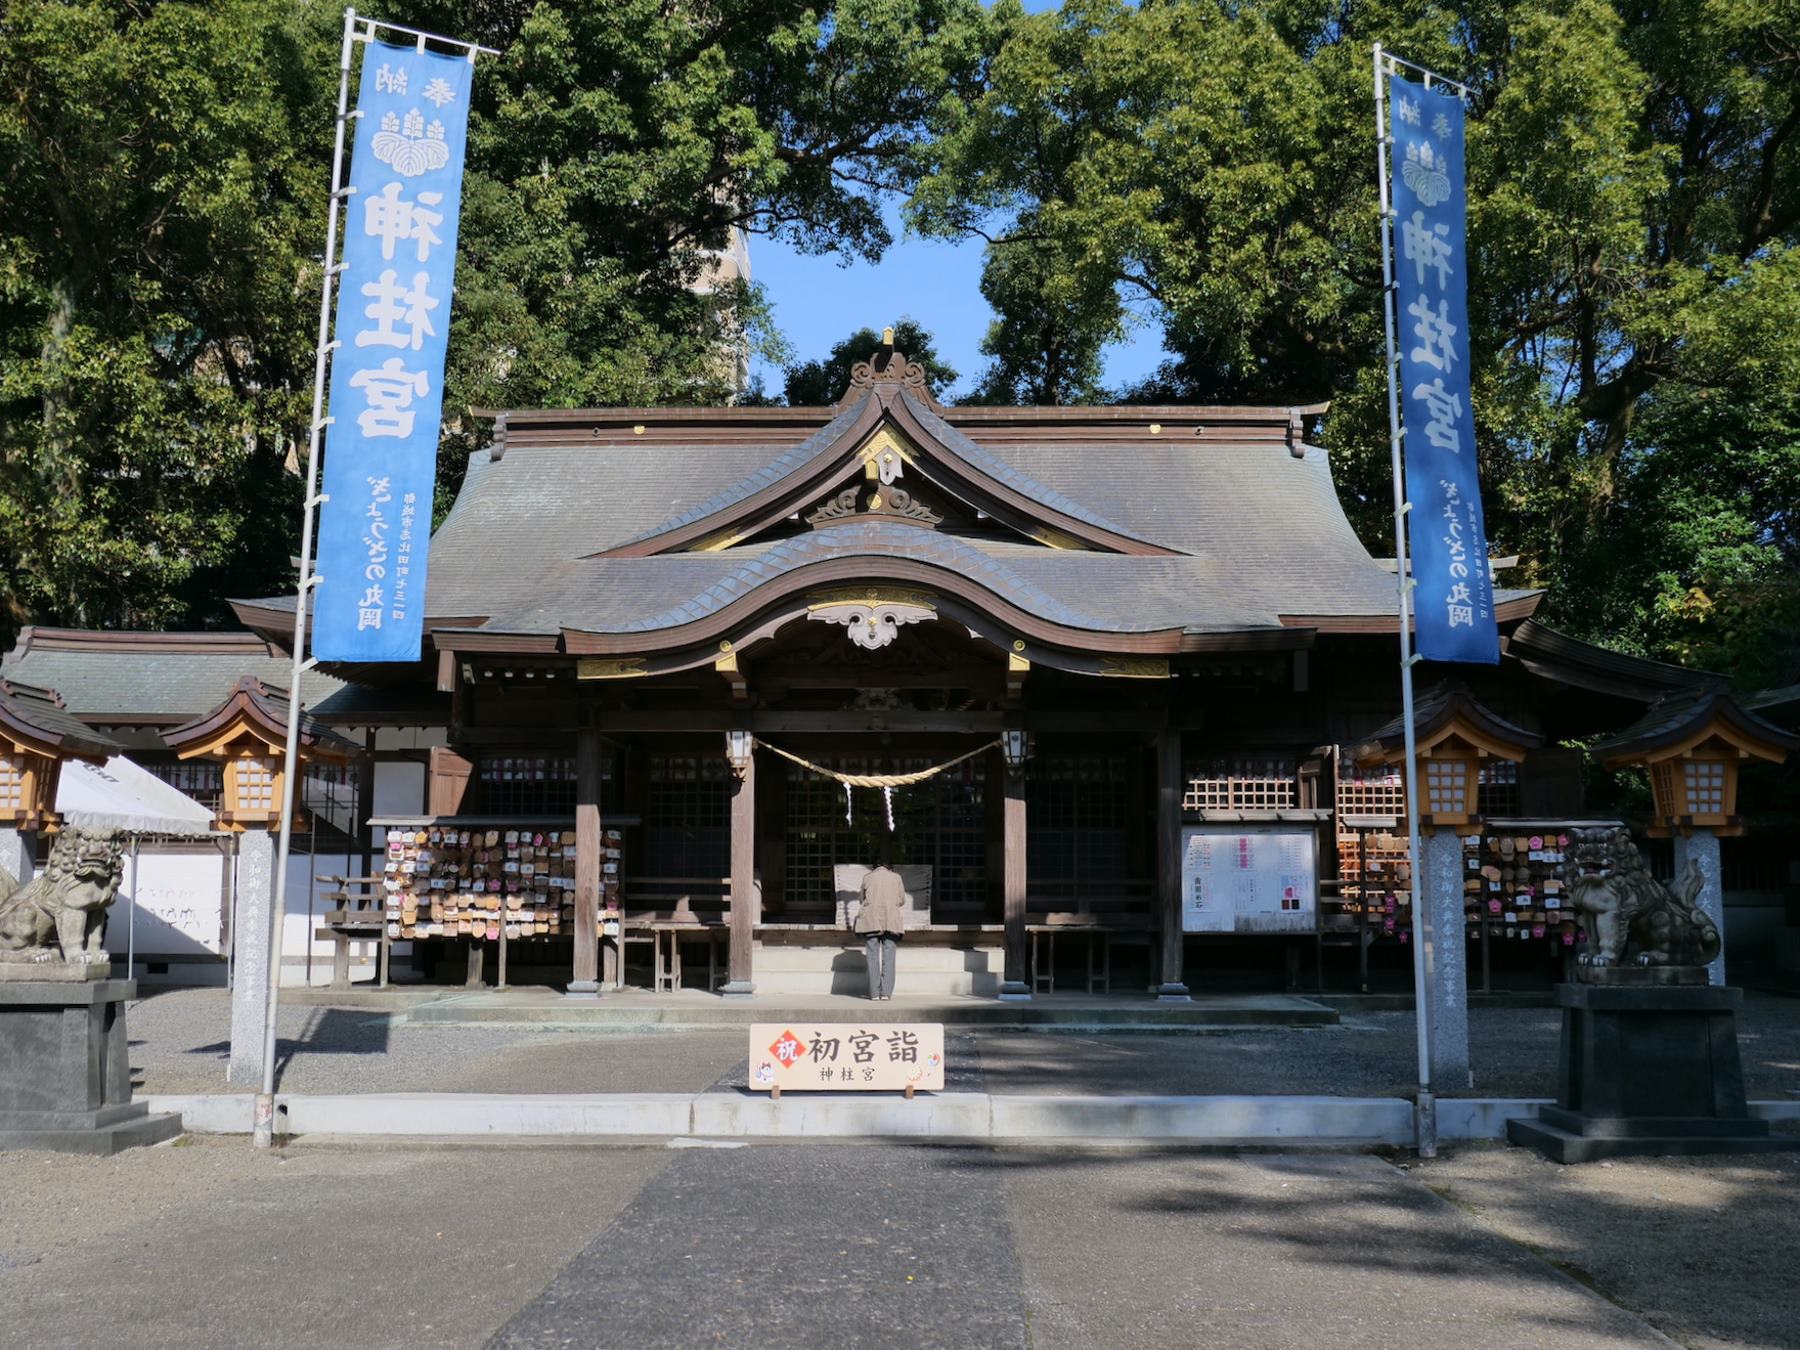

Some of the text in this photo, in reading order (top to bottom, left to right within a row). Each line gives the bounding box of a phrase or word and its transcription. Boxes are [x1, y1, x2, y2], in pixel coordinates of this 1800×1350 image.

[775, 1036, 799, 1062] 祝
[807, 1029, 920, 1065] 初宮詣
[819, 1066, 876, 1082] 神柱宮
